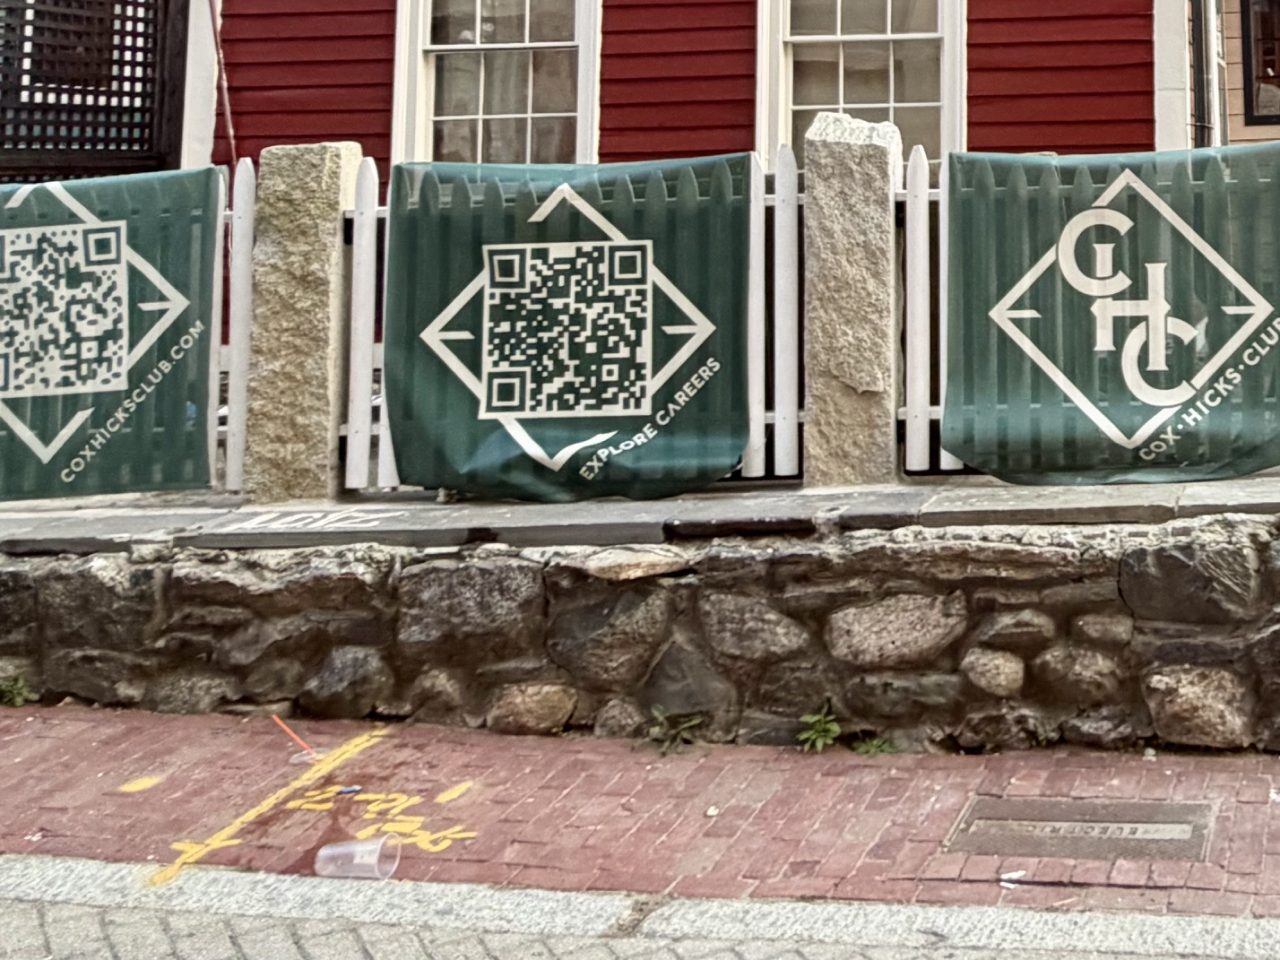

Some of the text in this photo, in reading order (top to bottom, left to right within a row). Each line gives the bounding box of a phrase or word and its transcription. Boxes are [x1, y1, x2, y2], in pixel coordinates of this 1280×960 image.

[60, 319, 205, 482] COXHICKSCLUB.COM
[579, 357, 720, 480] EXPLORE CAREERS
